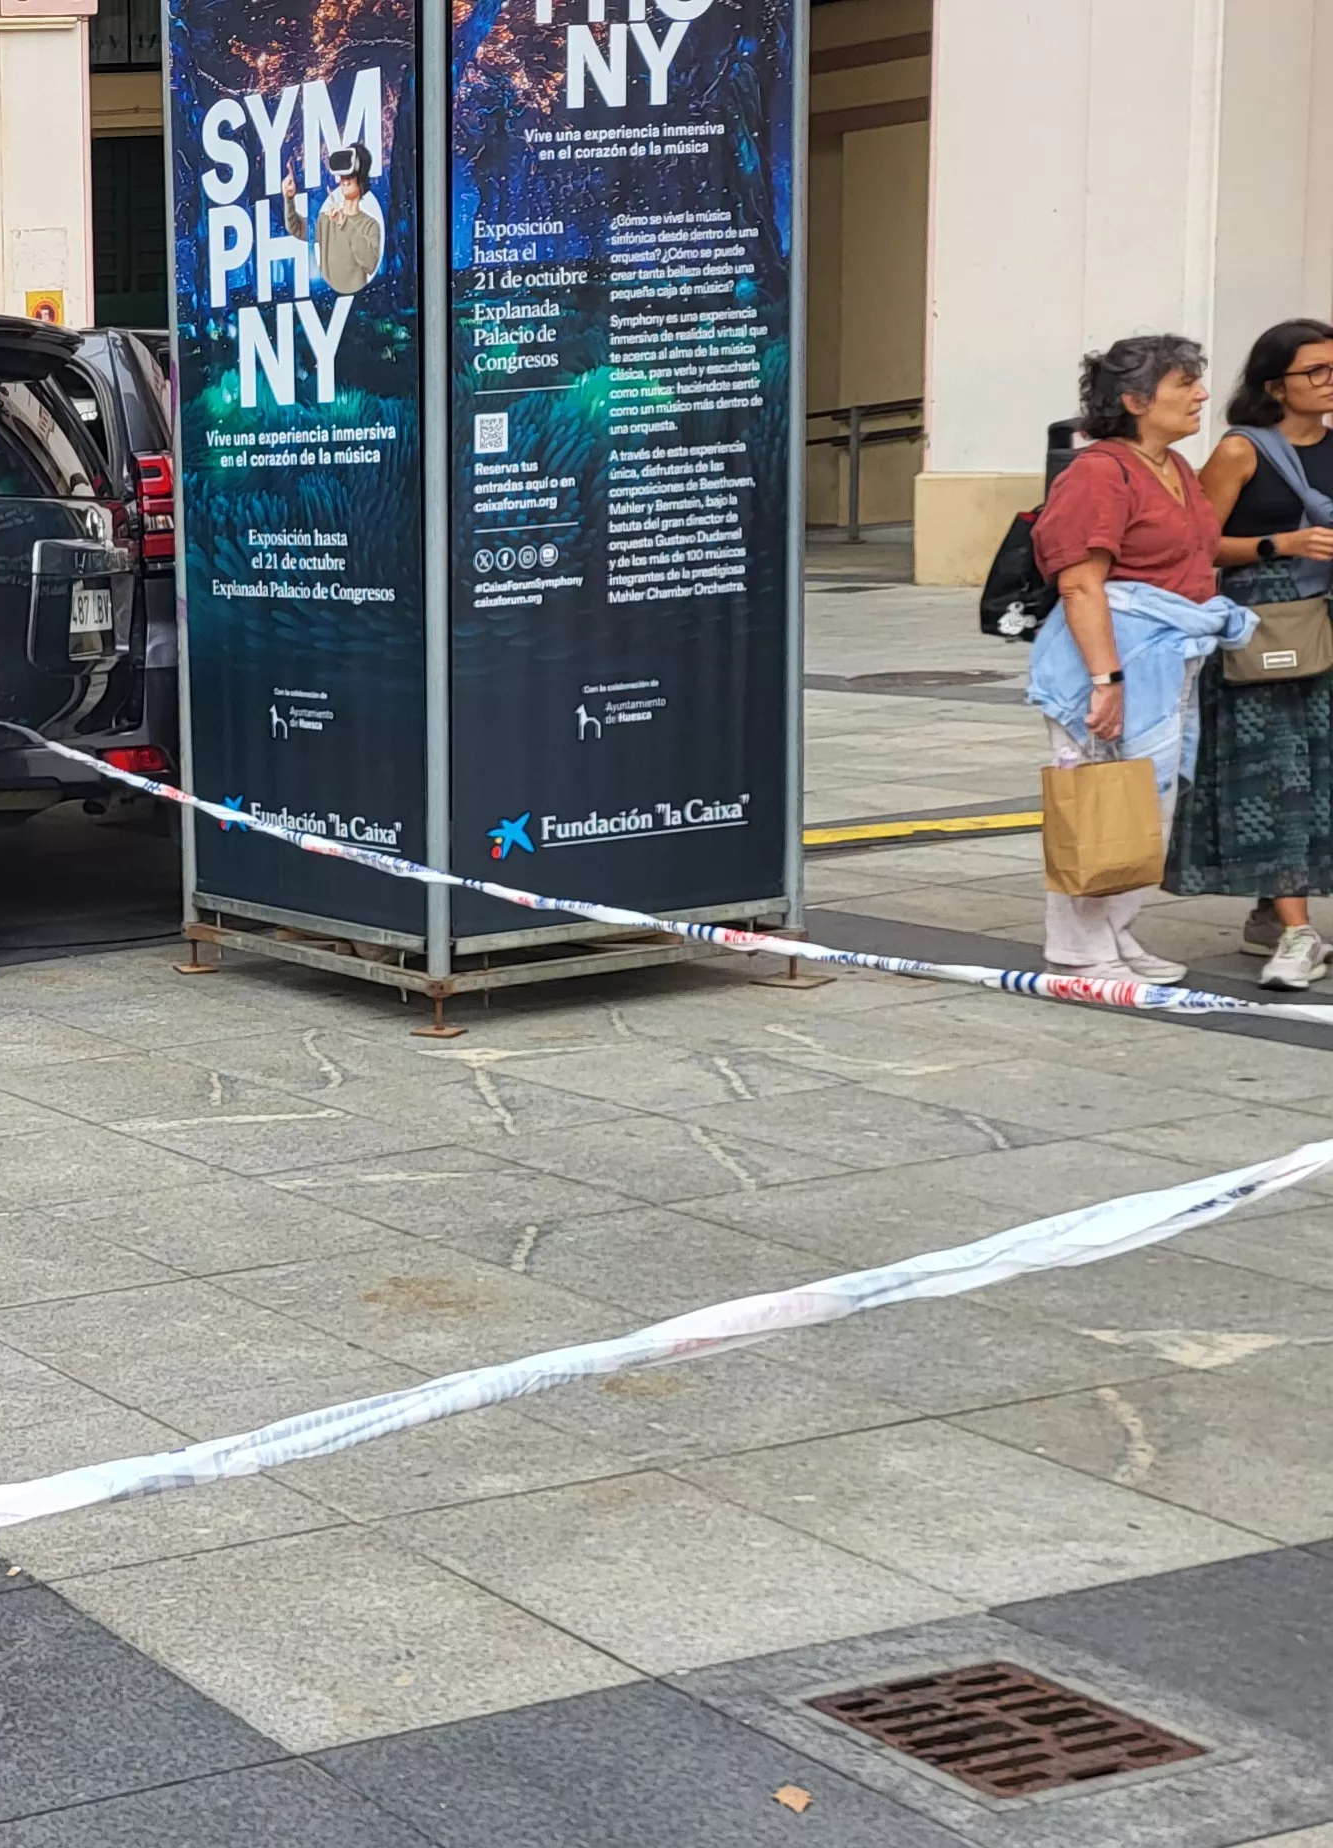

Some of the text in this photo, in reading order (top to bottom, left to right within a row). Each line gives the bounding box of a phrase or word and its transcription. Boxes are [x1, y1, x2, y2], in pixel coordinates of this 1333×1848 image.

[566, 21, 691, 109] NY
[201, 66, 383, 205] SYM
[525, 120, 725, 144] Vive una experiencia inmersiva
[539, 138, 709, 161] en el corazón de la música
[474, 219, 564, 241] Exposición
[610, 214, 649, 230] ¿Cómo
[649, 216, 662, 225] se
[685, 211, 695, 223] la
[696, 209, 732, 223] música
[473, 242, 537, 265] hasta el
[474, 267, 588, 290] 21 de octubre
[474, 298, 560, 324] Explanada
[473, 324, 557, 347] Palacio de
[238, 295, 354, 408] NY
[473, 351, 559, 374] Congresos
[206, 421, 396, 449] Vive una experiencia inmersiva
[220, 445, 381, 468] en el corazón de la música
[473, 460, 539, 476] Reserva tus
[473, 480, 524, 495] entradas
[248, 526, 348, 550] Exposición hasta
[251, 552, 346, 572] el 21 de octubre
[211, 578, 396, 606] Explanada Palacio de Congresos
[540, 808, 653, 841] Fundación
